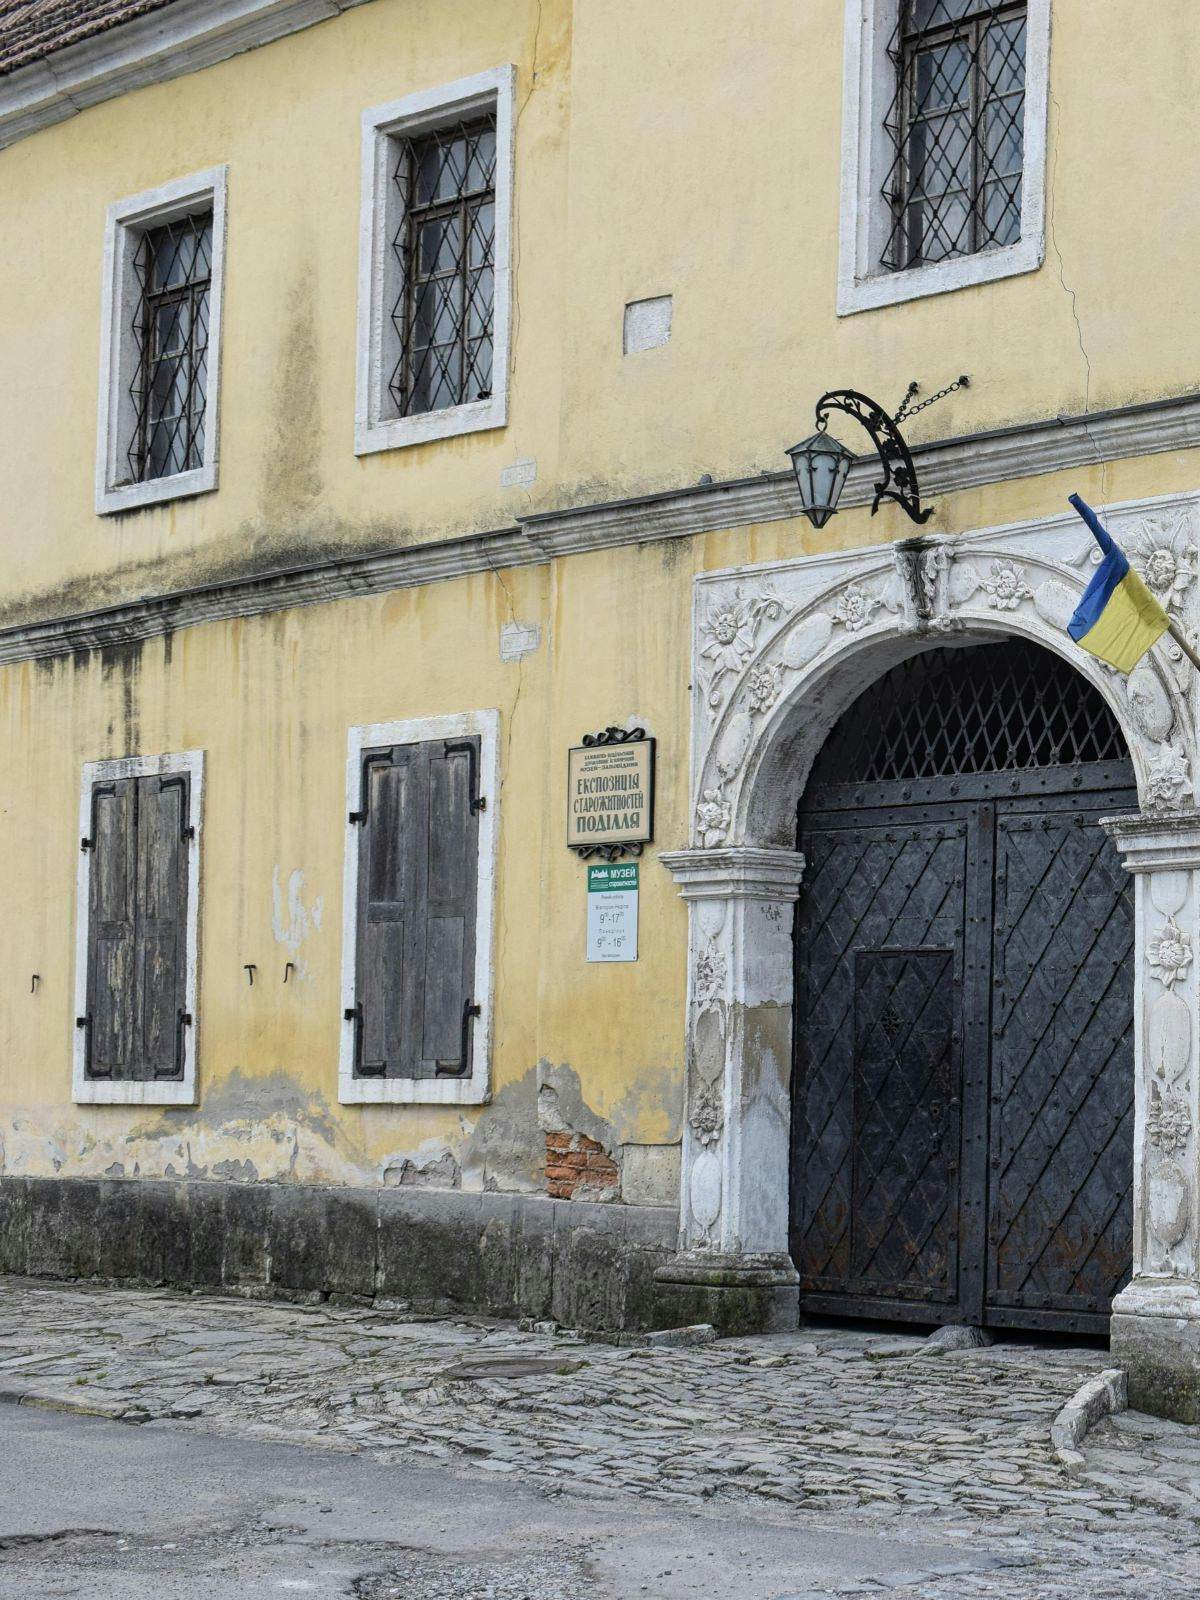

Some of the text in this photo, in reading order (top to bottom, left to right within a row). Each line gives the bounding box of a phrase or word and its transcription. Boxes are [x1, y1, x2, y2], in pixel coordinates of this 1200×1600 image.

[577, 773, 640, 795] ЕКСПОЗИЦІЯ
[573, 790, 644, 814] СТАРОЖИТНОСТЕЙ
[576, 812, 640, 833] ПОДІЛЛЯ
[610, 866, 636, 879] МУЗЕЙ
